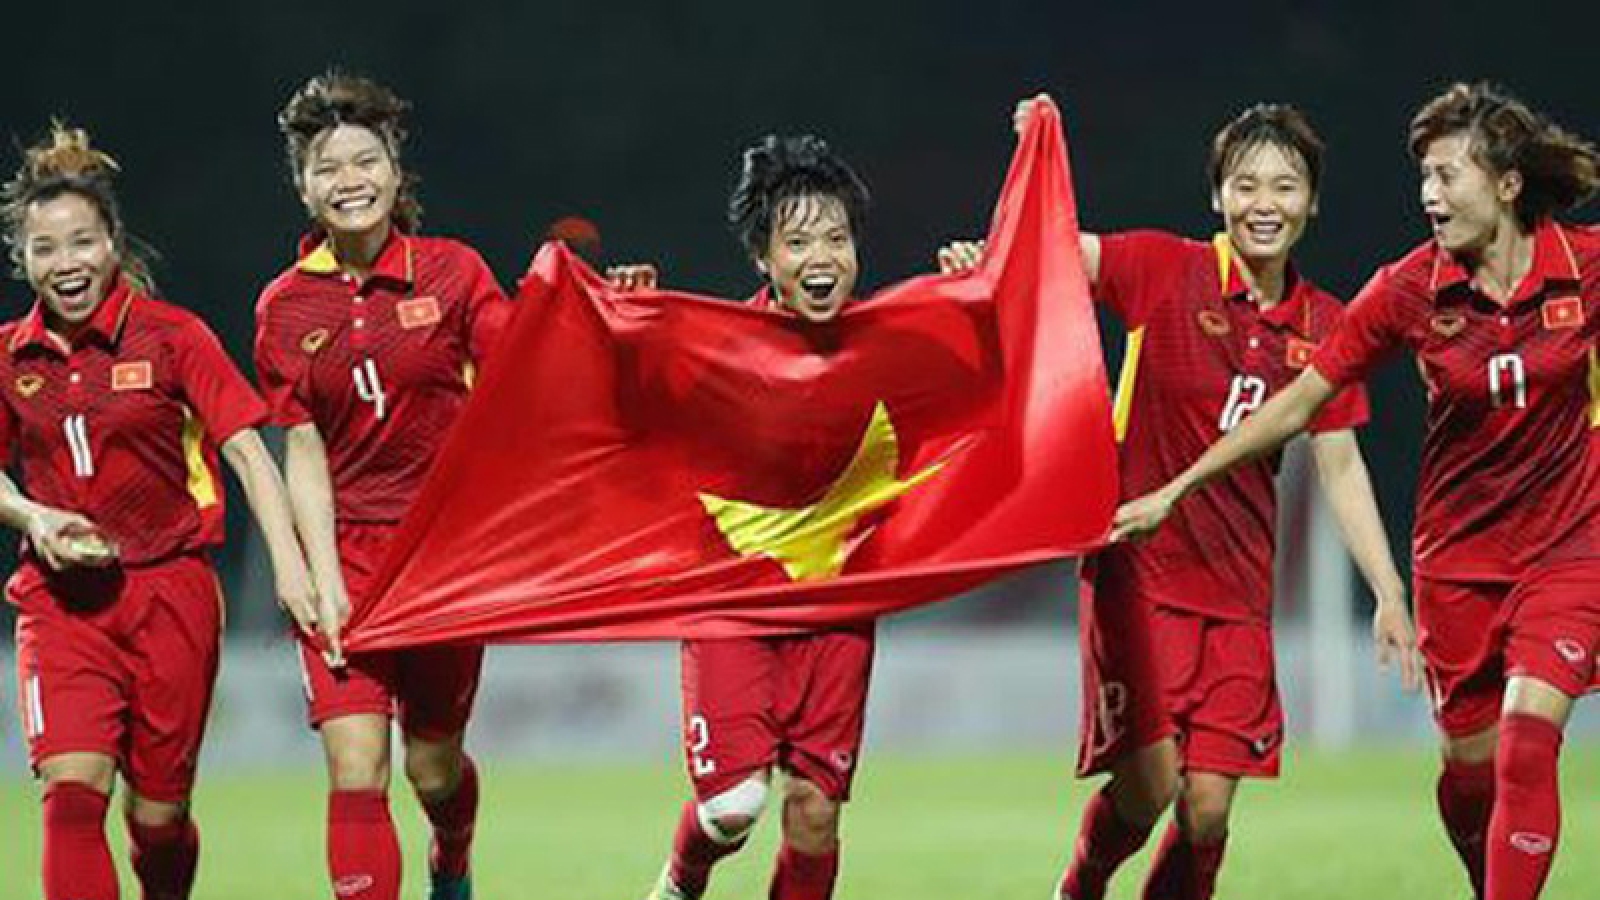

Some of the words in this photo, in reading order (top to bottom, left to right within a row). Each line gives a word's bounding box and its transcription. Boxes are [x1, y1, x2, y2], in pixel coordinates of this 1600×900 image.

[352, 358, 385, 419] 4
[1218, 374, 1266, 430] 12
[62, 412, 94, 476] 11
[690, 715, 715, 776] 2
